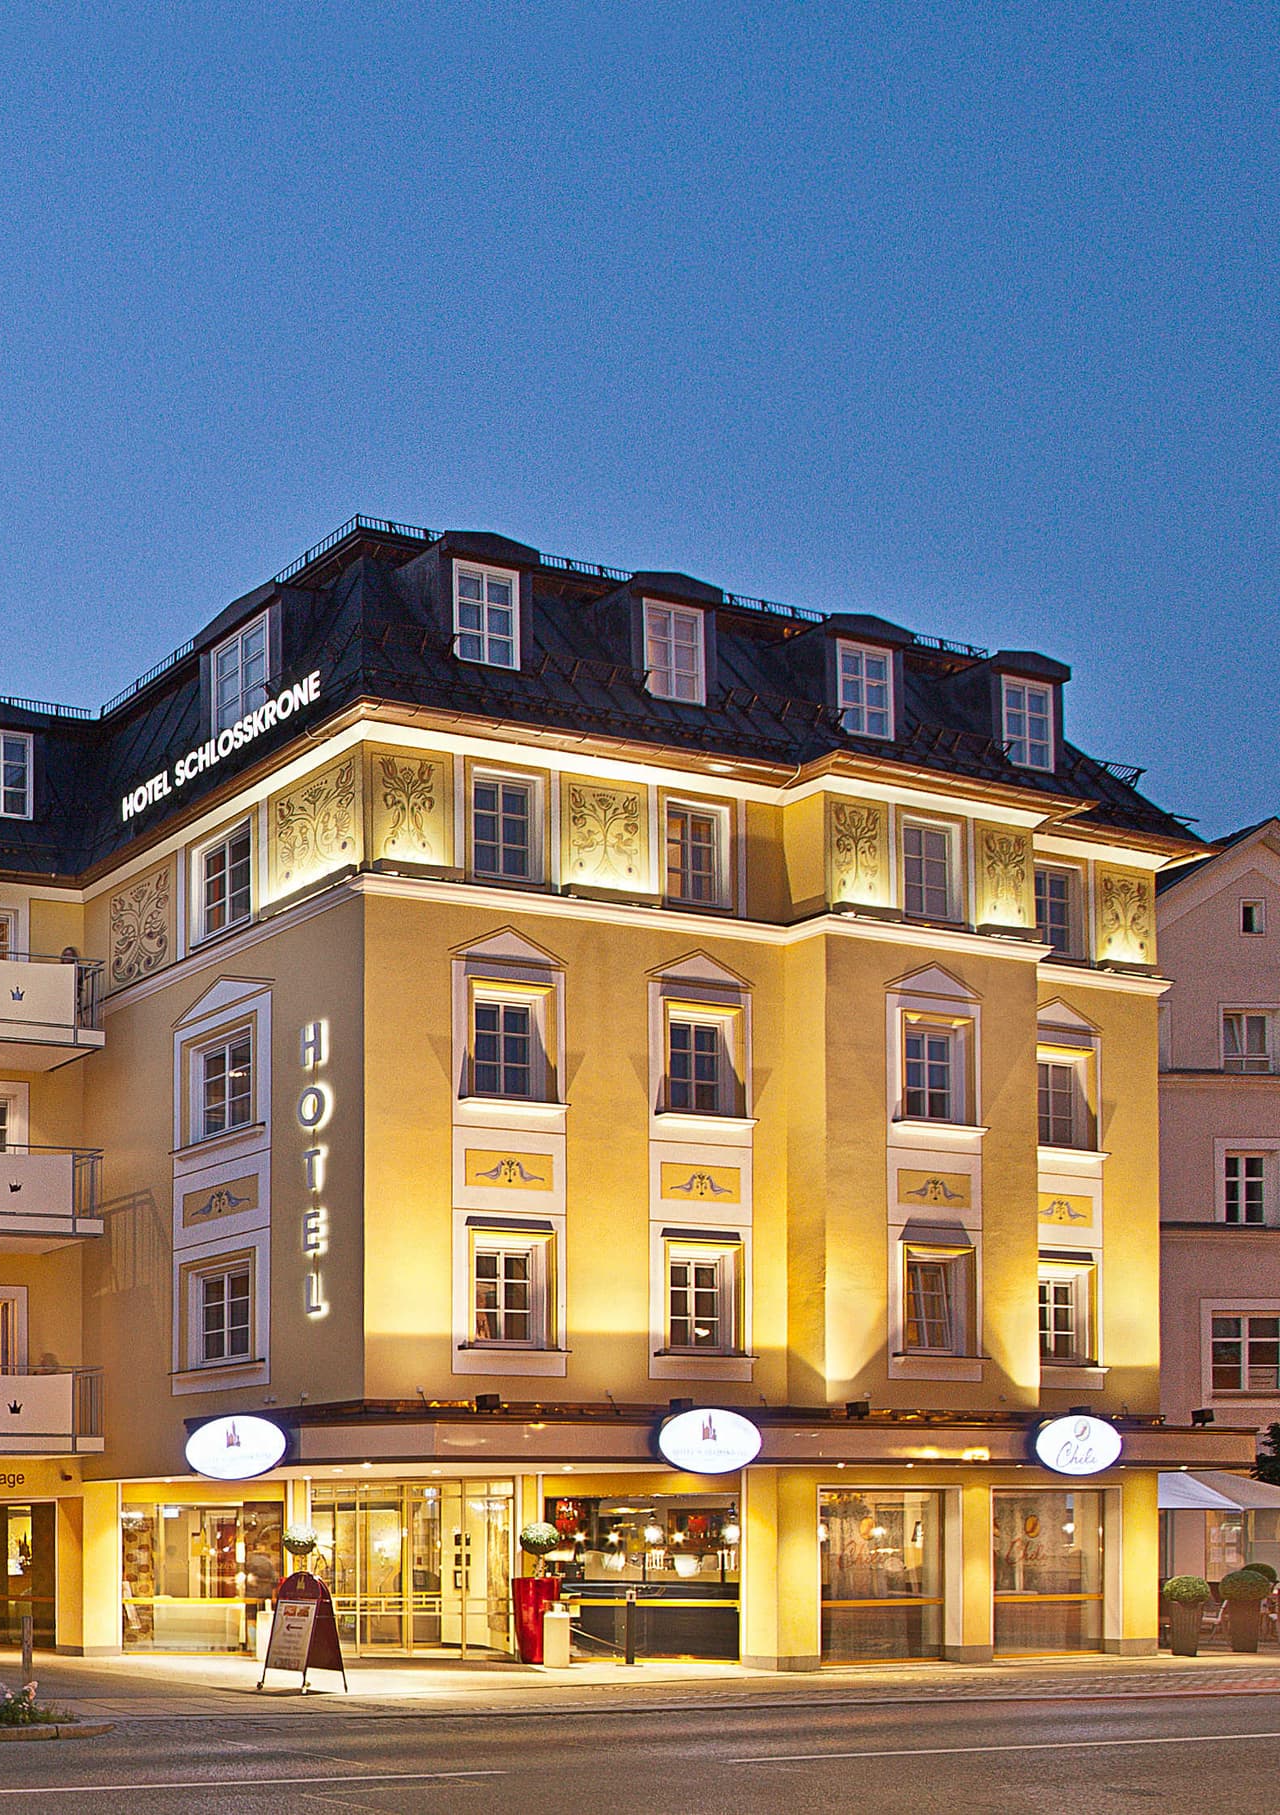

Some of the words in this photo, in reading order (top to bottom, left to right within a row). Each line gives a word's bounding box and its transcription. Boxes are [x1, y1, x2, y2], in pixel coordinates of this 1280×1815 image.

[122, 770, 172, 822] HOTEL
[174, 670, 321, 787] SCHLOSSKRONE
[297, 1020, 331, 1318] HOTEL
